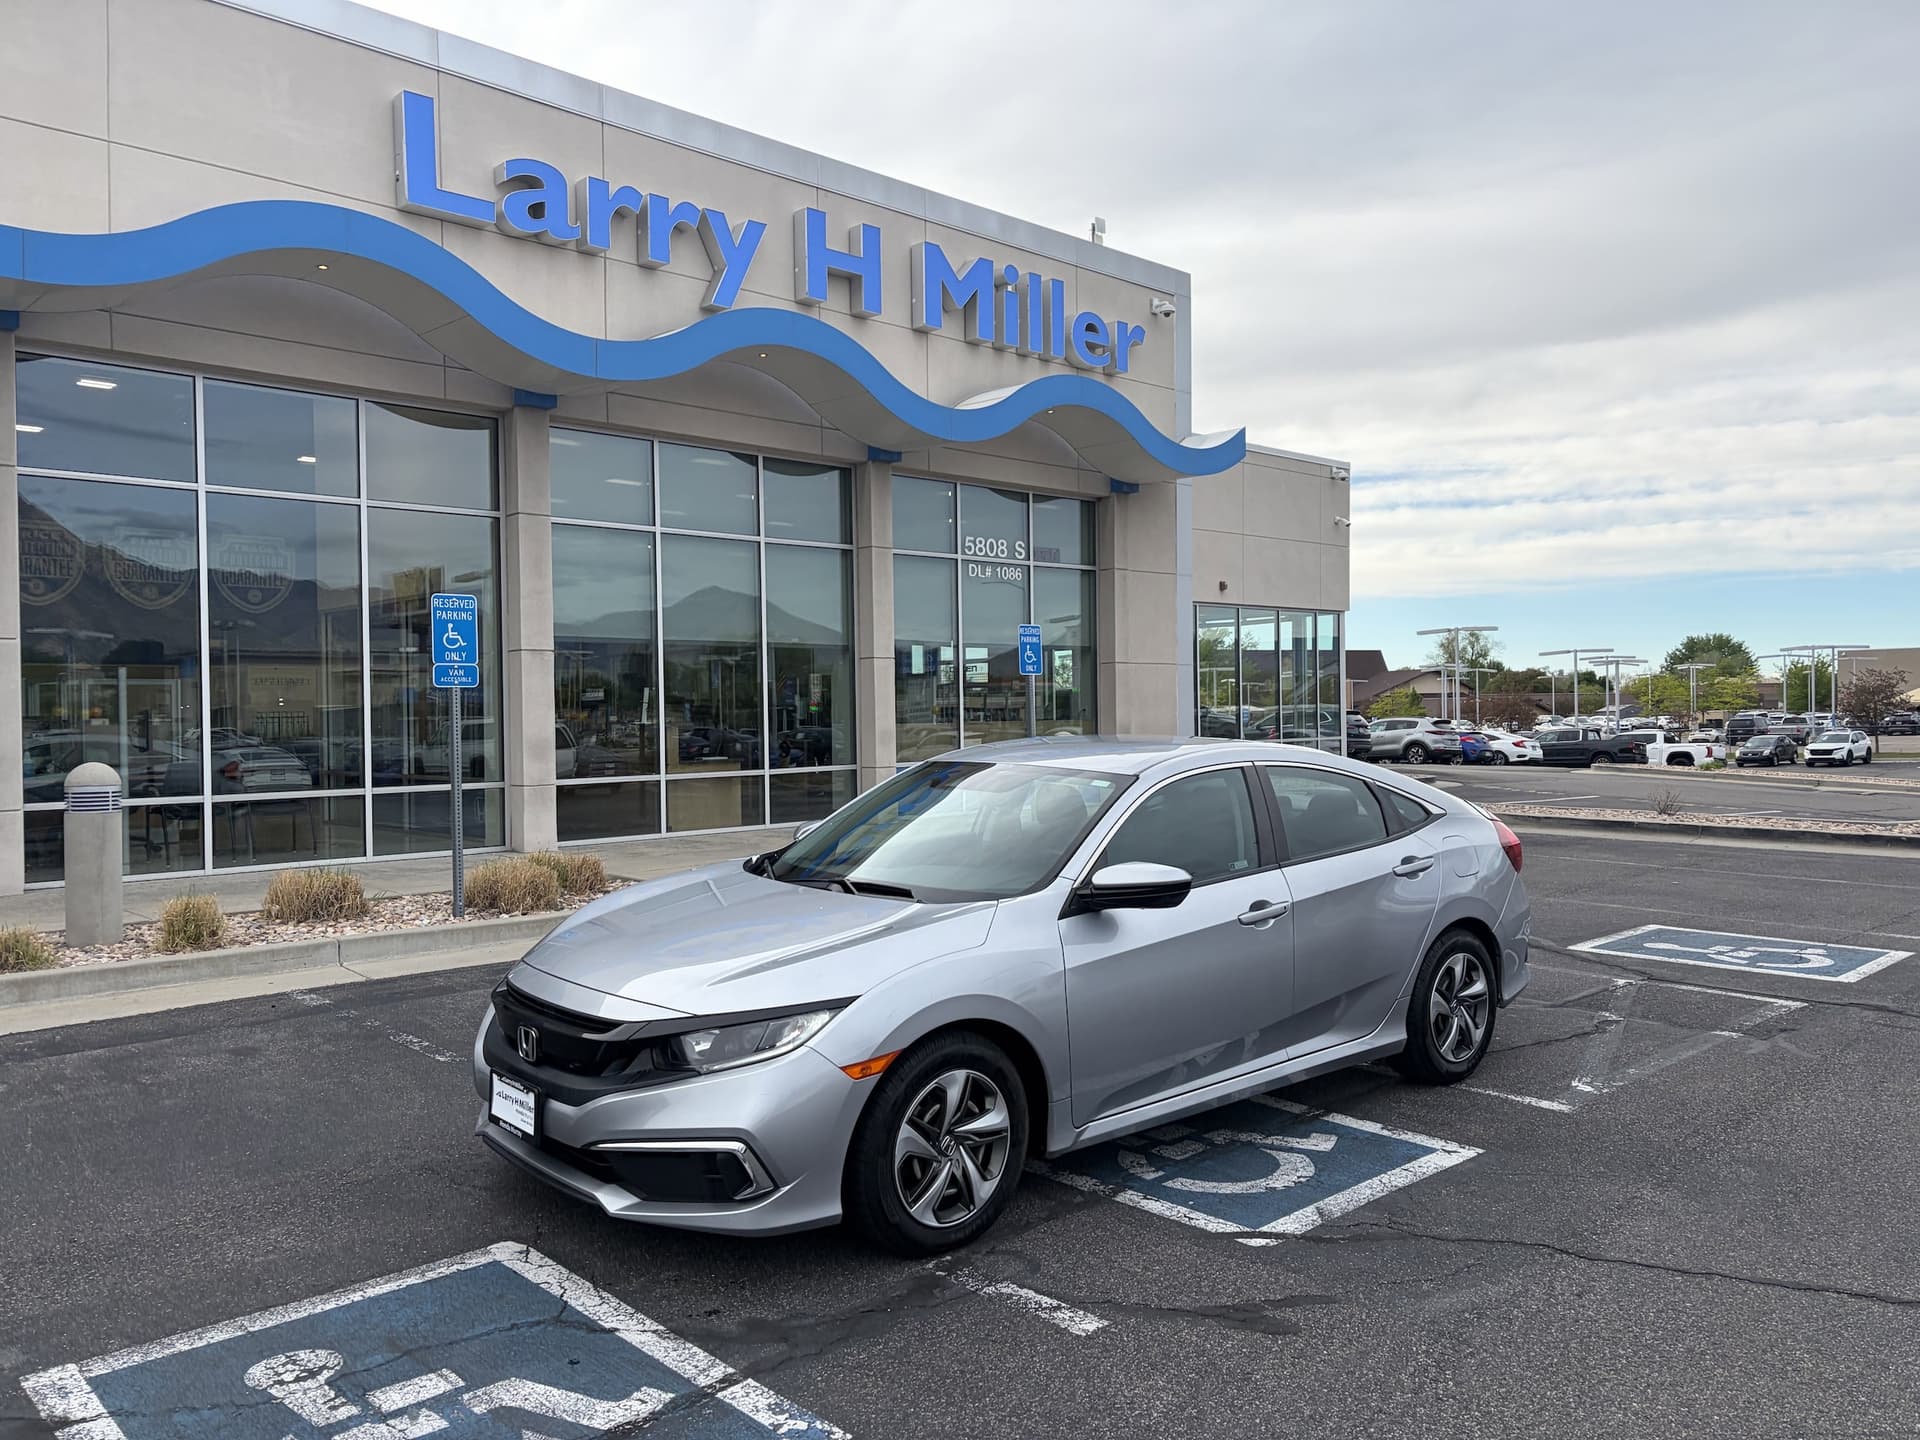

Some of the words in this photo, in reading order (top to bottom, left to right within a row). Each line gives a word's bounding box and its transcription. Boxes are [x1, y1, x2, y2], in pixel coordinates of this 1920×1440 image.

[395, 88, 768, 311] Larry
[797, 206, 882, 318] H
[913, 240, 1147, 374] Miller
[964, 536, 1008, 558] 5808
[1014, 540, 1026, 560] S
[968, 563, 992, 578] DL#
[996, 566, 1022, 580] 1086
[433, 598, 475, 609] RESERVED
[436, 610, 473, 621] PARKING
[445, 651, 467, 661] ONLY
[448, 668, 465, 677] VAN
[501, 1090, 515, 1106] Larry
